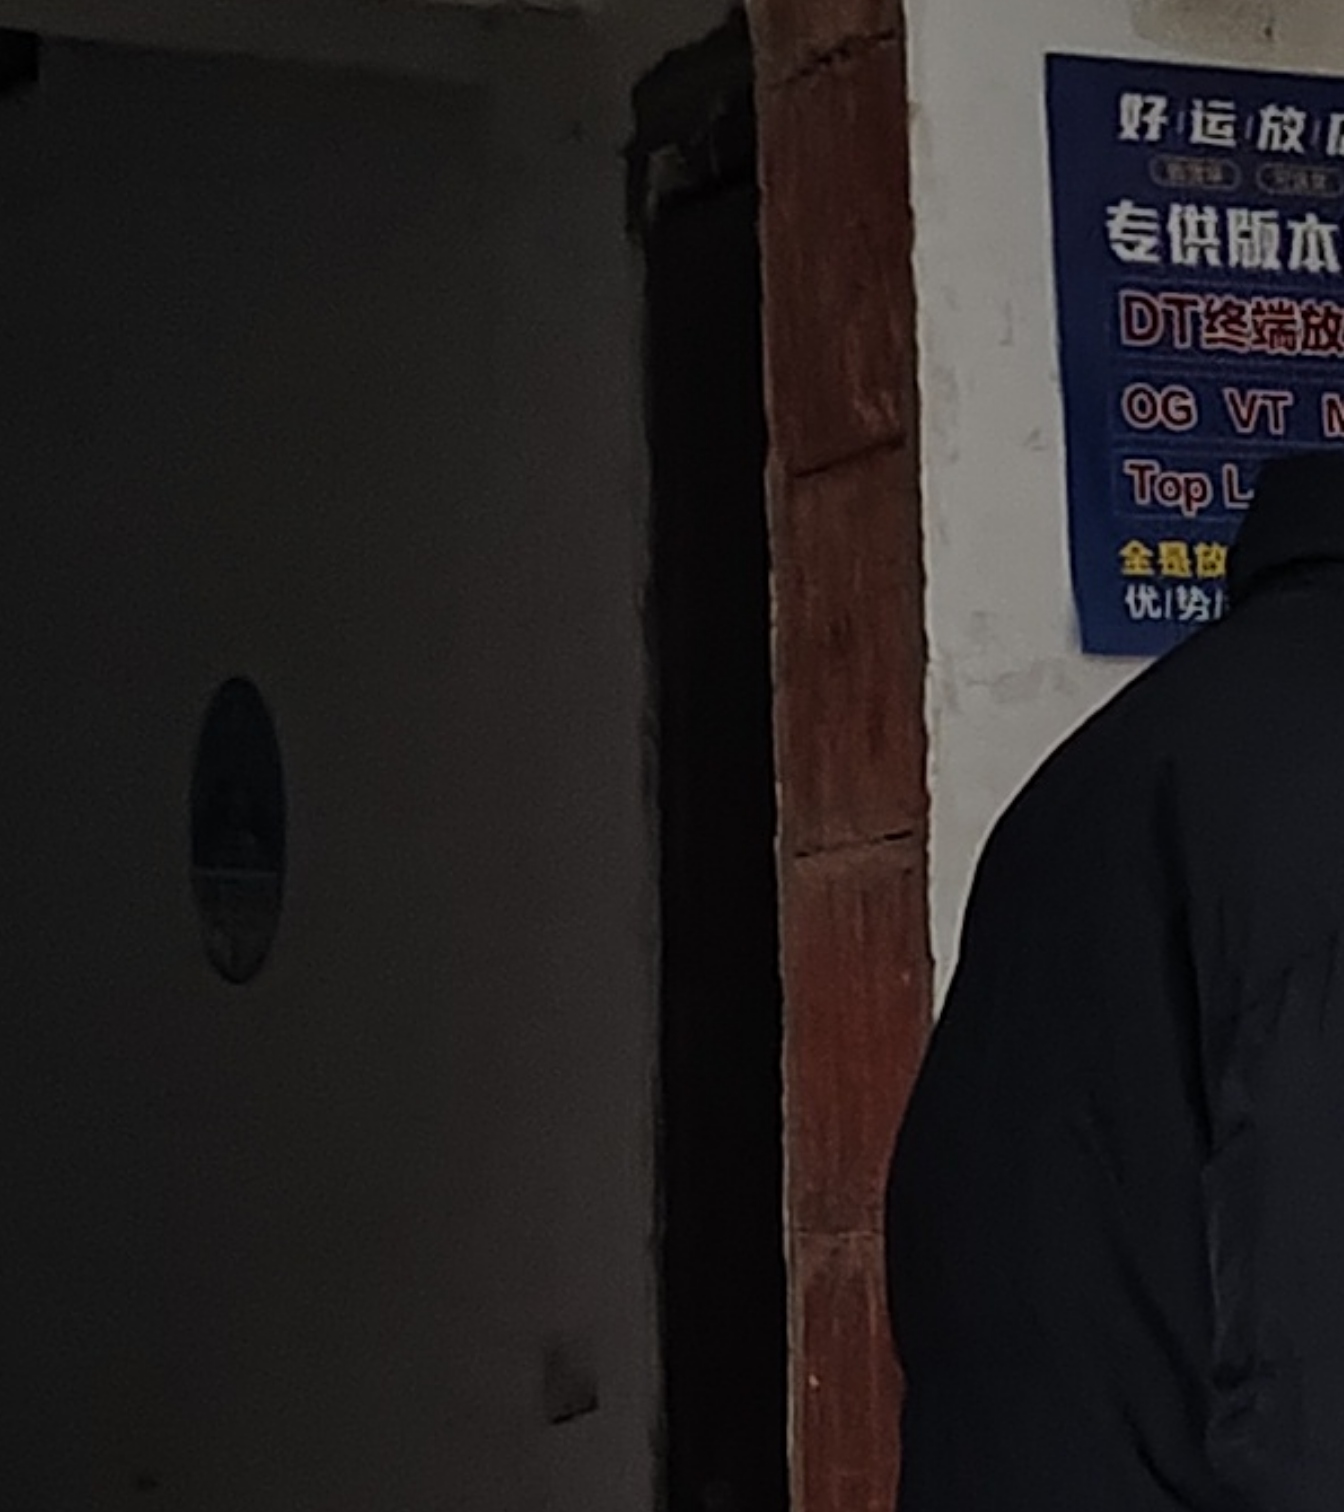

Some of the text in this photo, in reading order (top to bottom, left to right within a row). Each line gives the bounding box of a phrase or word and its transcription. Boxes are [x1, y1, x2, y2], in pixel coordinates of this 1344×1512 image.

[1122, 383, 1197, 430] OG
[1224, 386, 1293, 435] VT
[1123, 459, 1213, 517] Top
